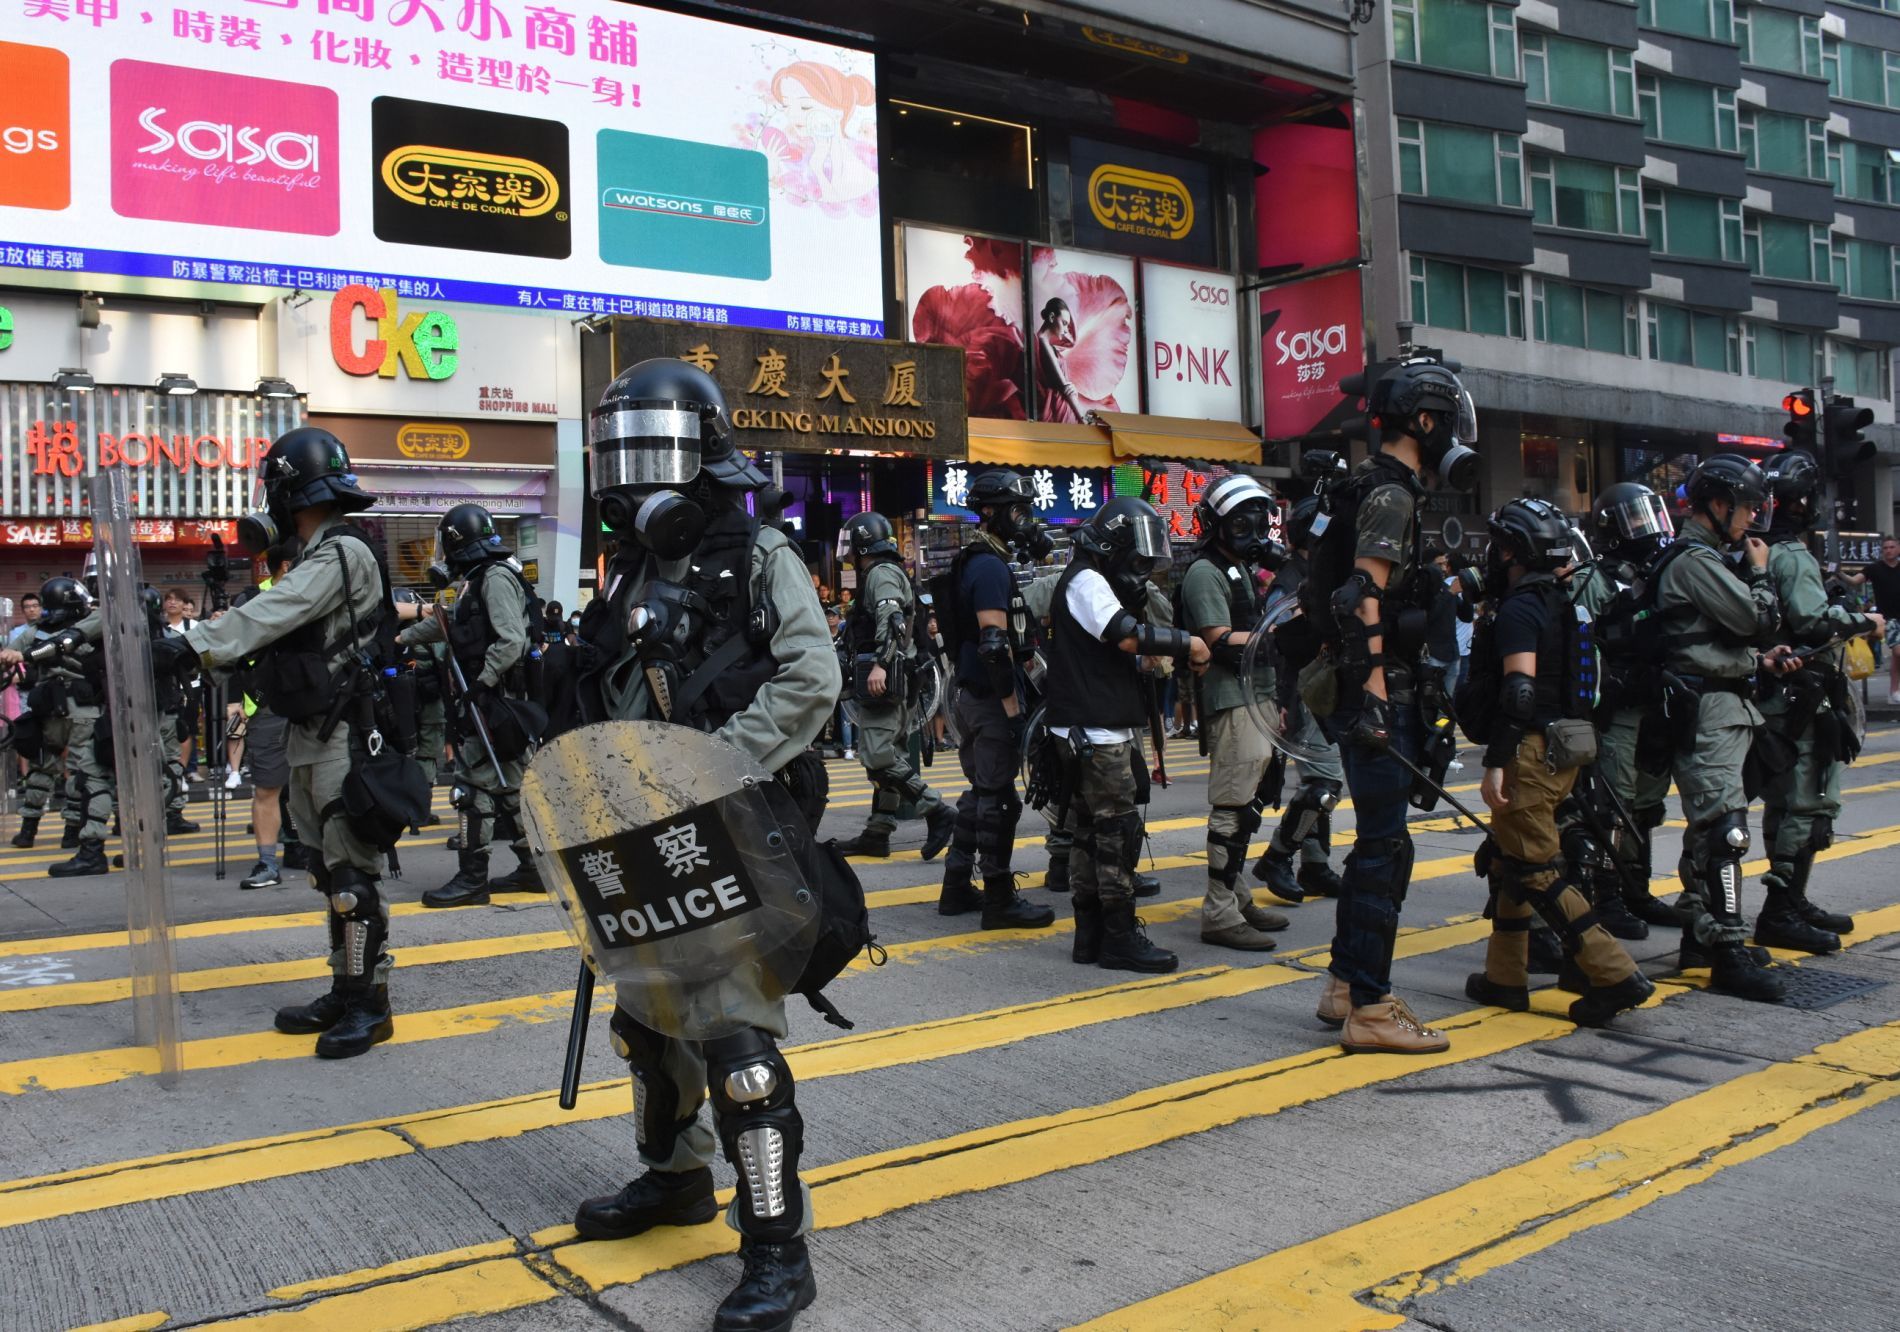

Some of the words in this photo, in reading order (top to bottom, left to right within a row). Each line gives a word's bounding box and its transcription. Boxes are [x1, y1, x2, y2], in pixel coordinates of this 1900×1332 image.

[132, 158, 199, 181] making
[203, 163, 239, 184] life
[242, 167, 321, 192] beautiful
[462, 202, 479, 212] DE
[480, 205, 519, 217] CORAL
[615, 193, 703, 214] watsons
[0, 246, 85, 269] 放催淚彈
[478, 400, 529, 413] SHOPPING
[532, 402, 558, 415] MALL
[818, 413, 936, 440] MANSIONS
[505, 499, 524, 508] Mall
[578, 822, 711, 900] 警察
[597, 874, 748, 943] POLICE
